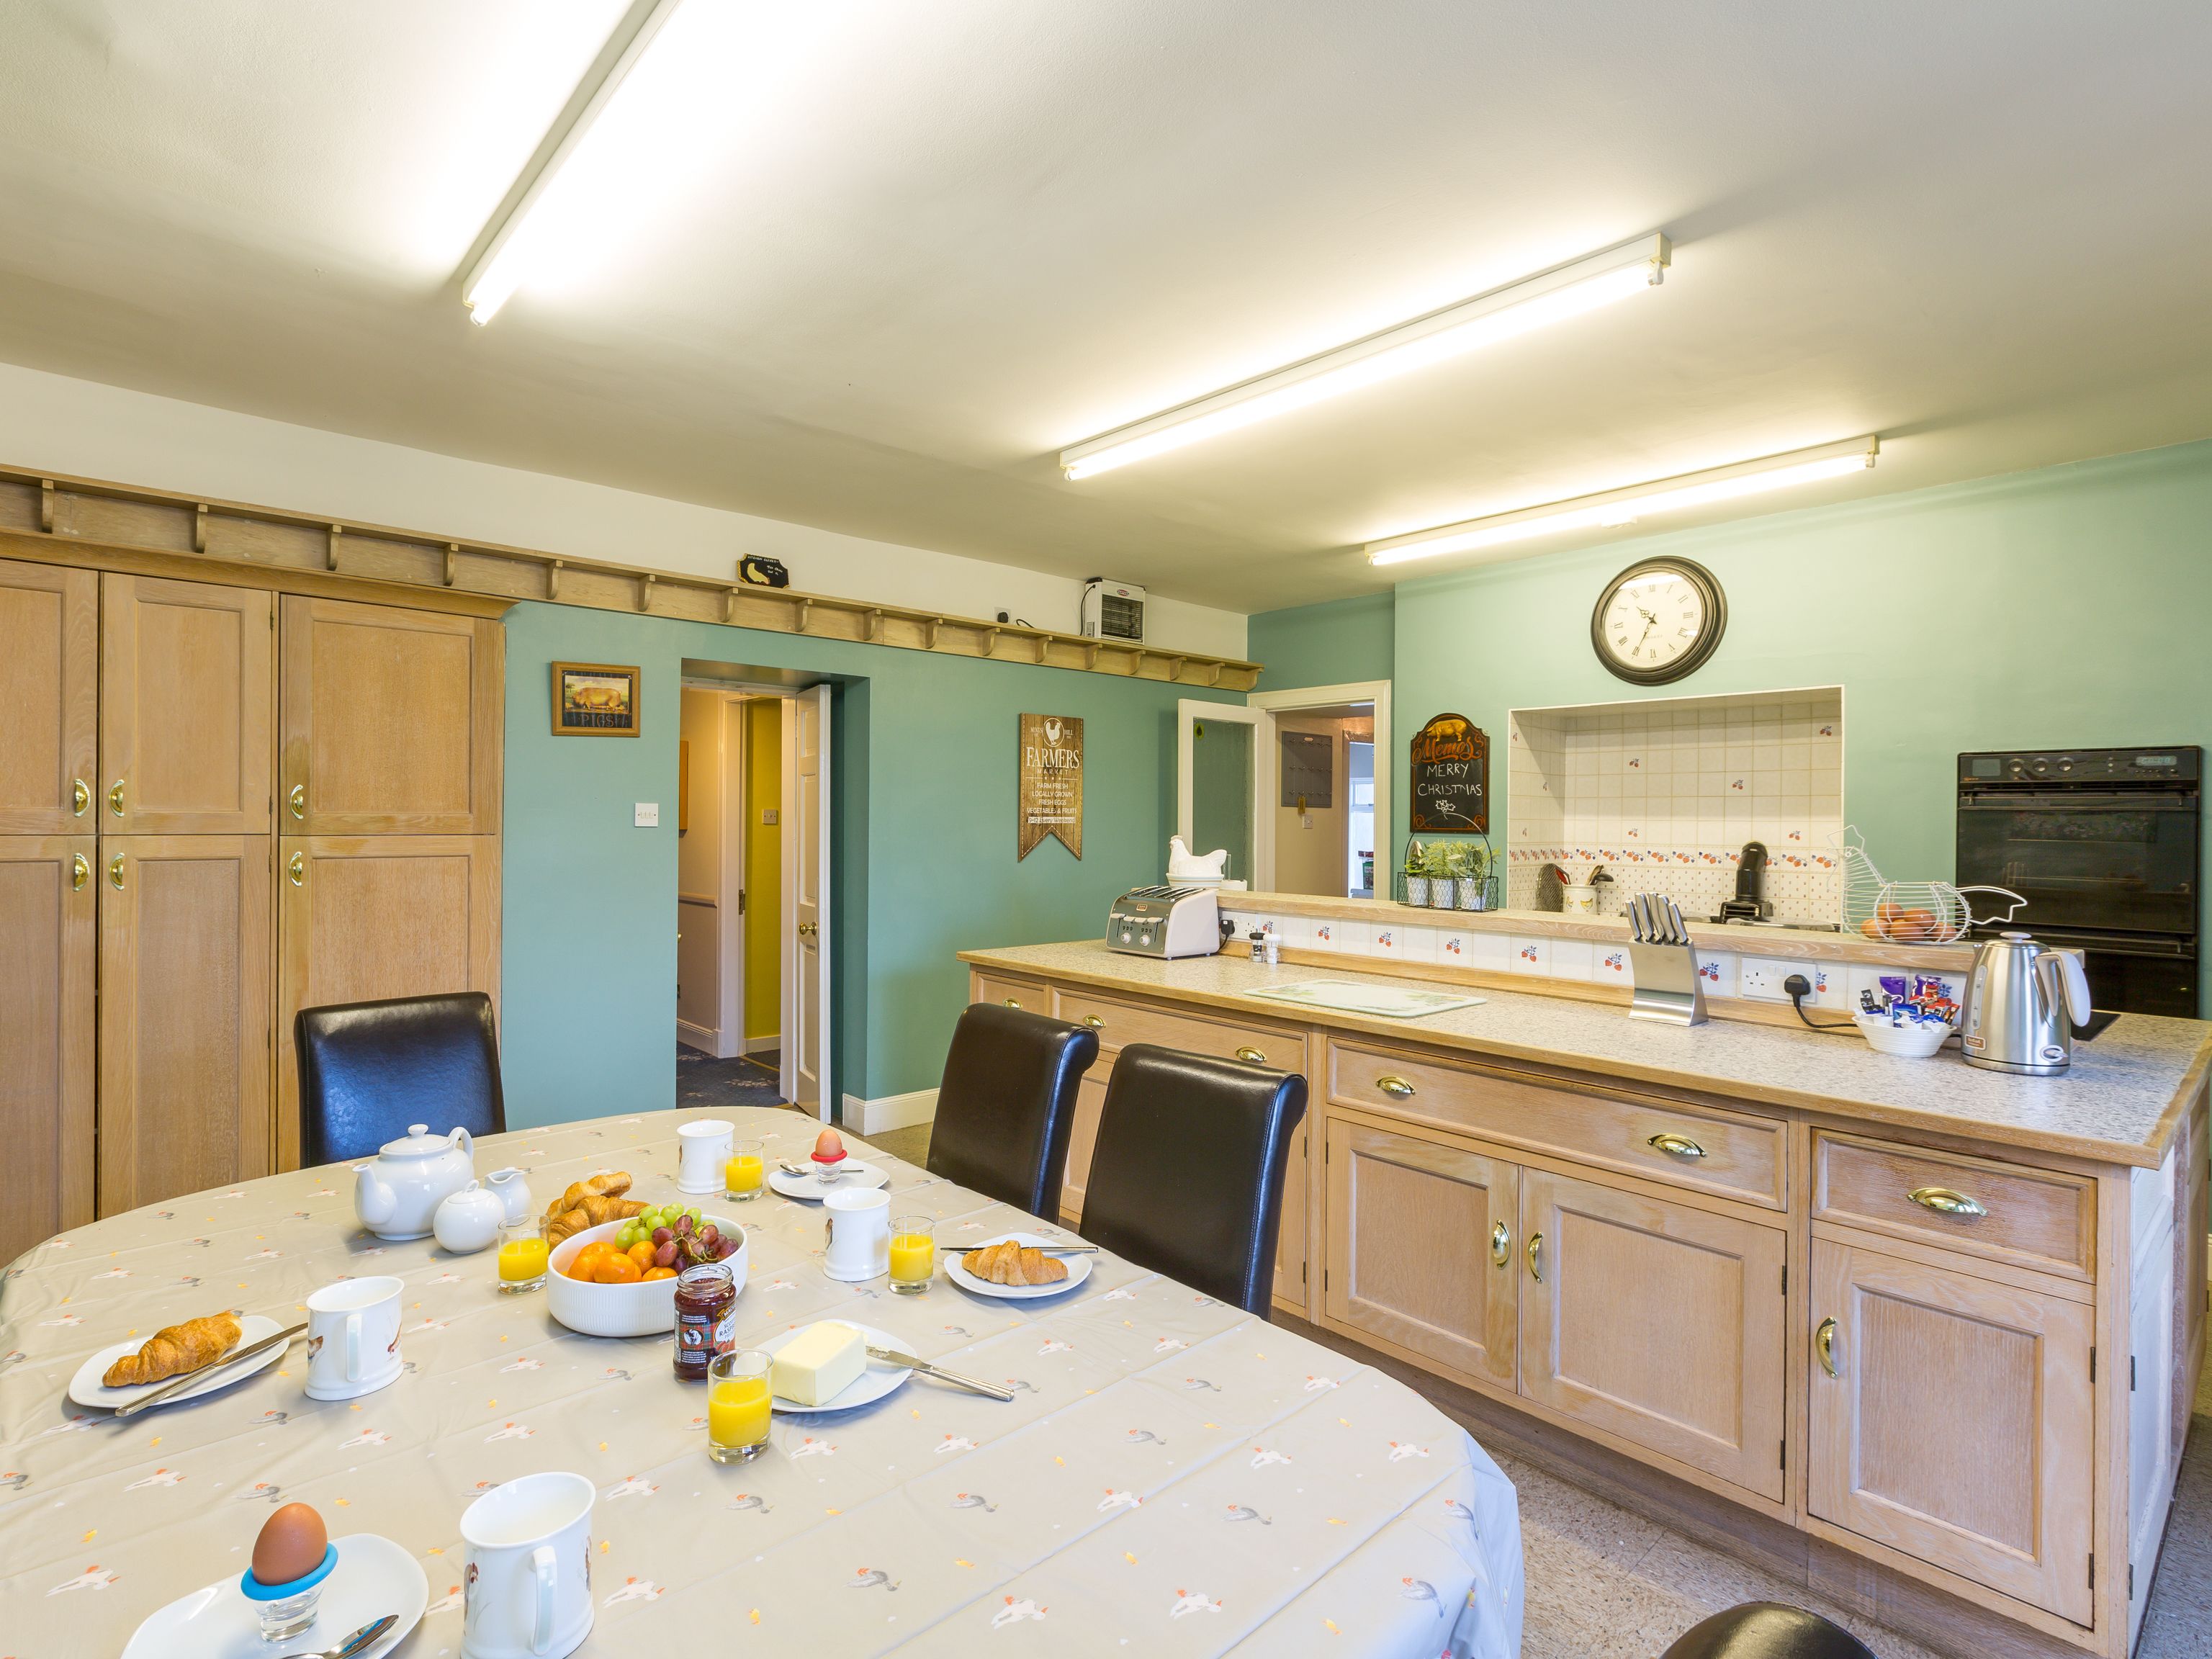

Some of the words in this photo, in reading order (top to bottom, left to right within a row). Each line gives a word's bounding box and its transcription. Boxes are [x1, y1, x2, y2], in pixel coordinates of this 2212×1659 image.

[581, 714, 614, 727] PIGS
[1026, 747, 1079, 769] FARMERS
[1426, 763, 1470, 778] MERRY
[1417, 783, 1483, 796] CHRISTMAS
